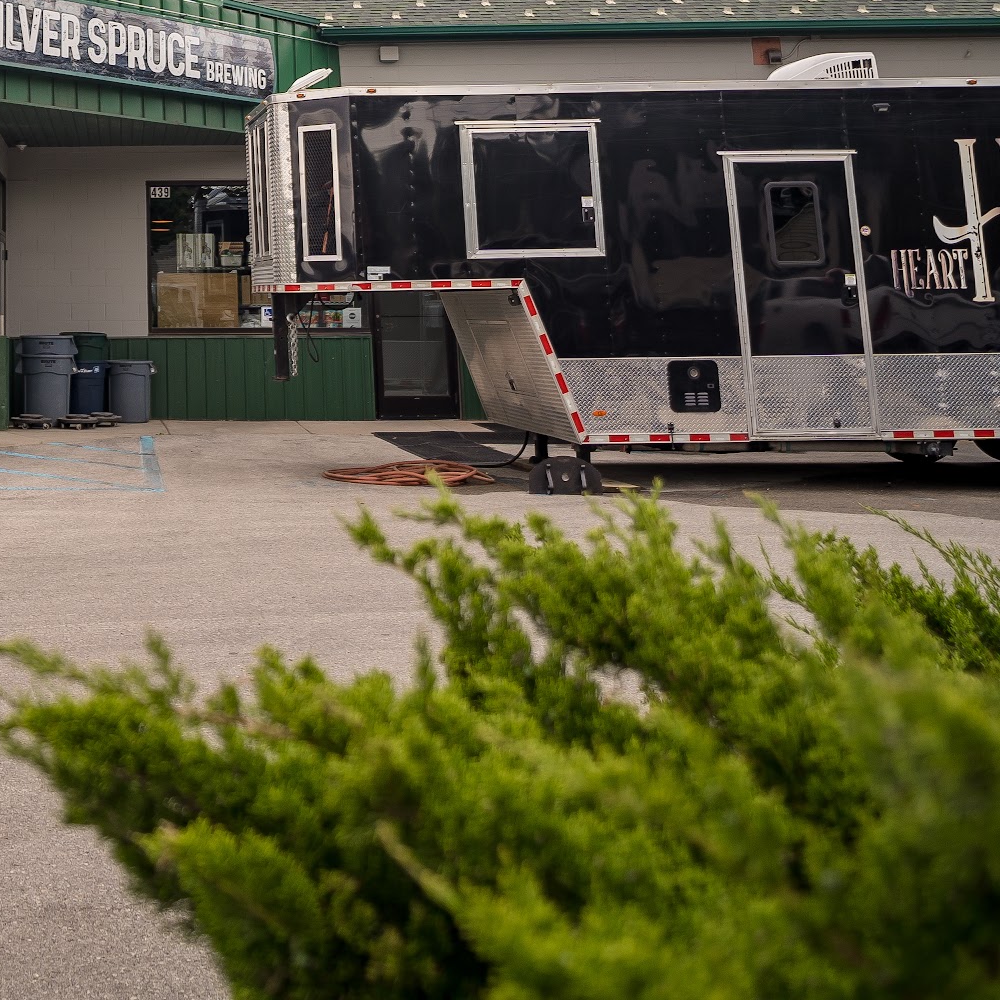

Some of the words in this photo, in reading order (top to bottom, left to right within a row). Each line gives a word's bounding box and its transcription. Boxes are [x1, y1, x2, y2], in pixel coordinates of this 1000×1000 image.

[88, 18, 201, 79] SPRUCE
[206, 60, 267, 90] BREWING
[151, 187, 169, 198] 439
[891, 248, 968, 298] HEART
